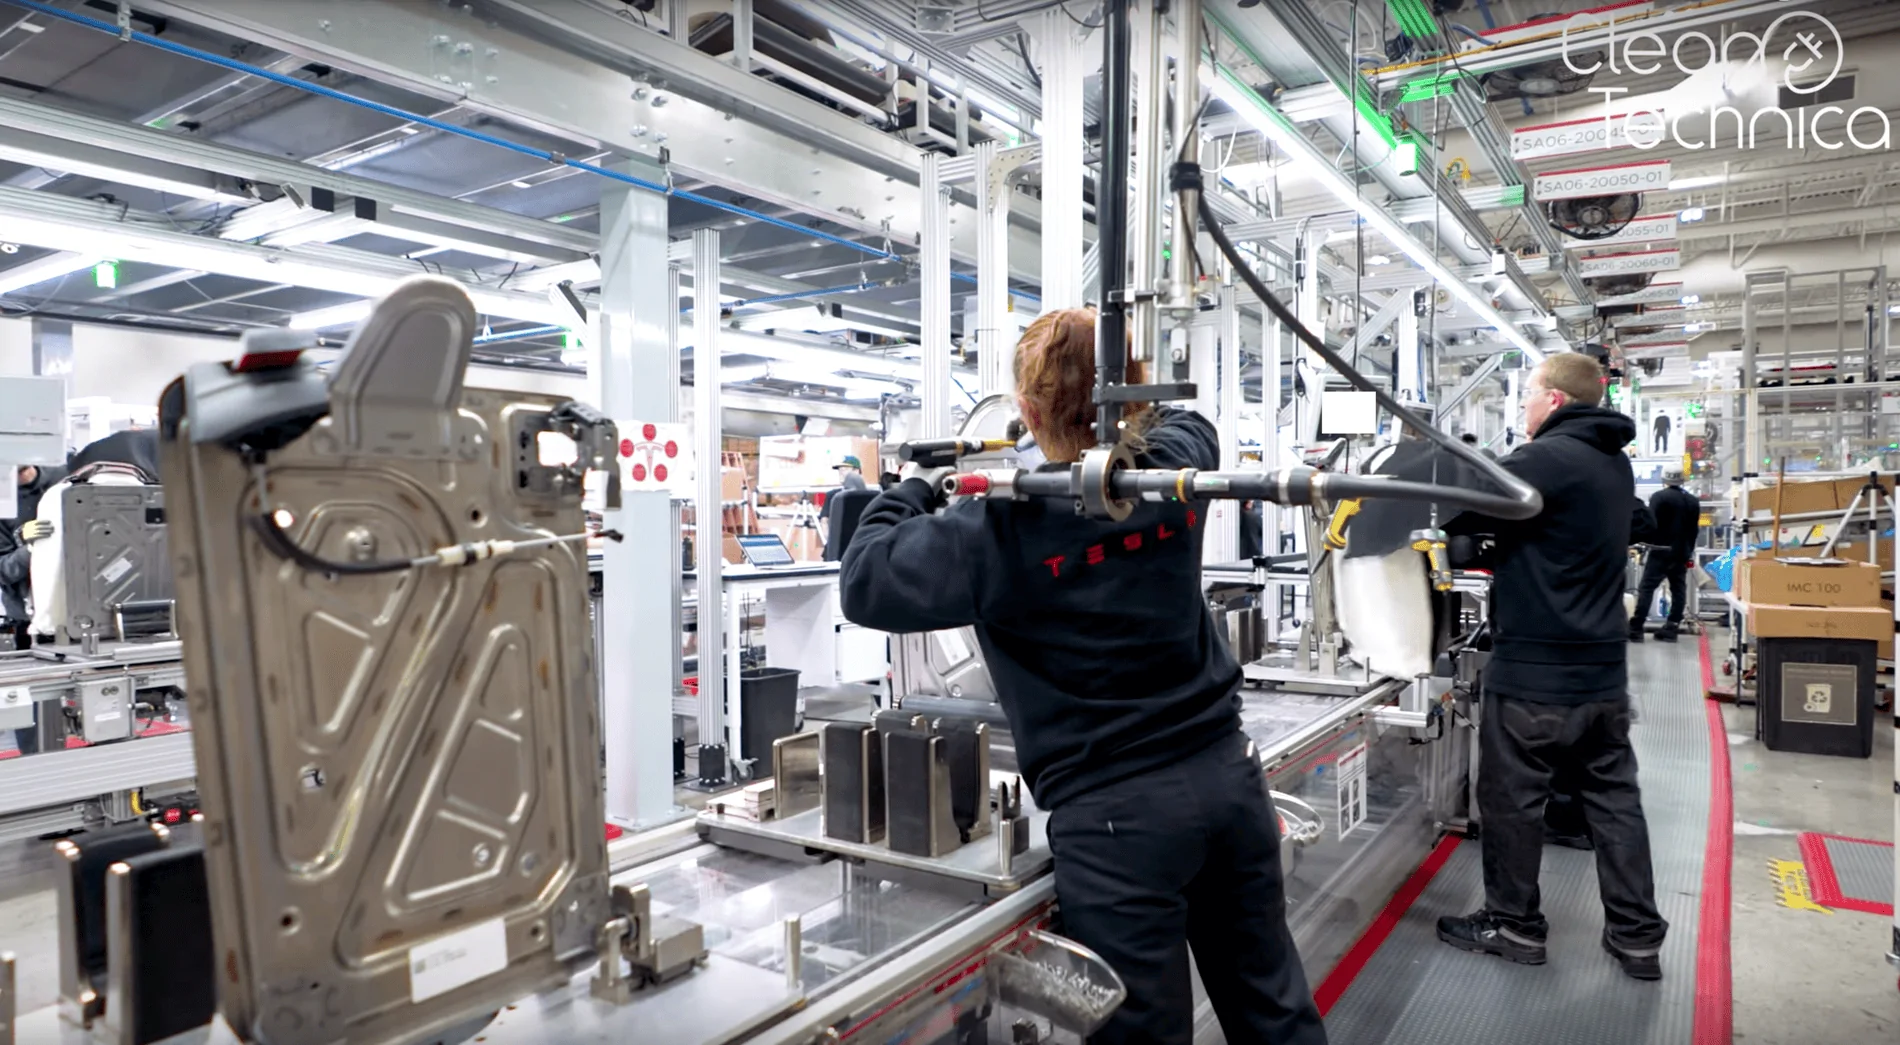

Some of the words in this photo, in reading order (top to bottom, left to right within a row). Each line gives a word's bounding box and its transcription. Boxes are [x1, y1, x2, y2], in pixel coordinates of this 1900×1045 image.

[1544, 171, 1662, 193] SA06-20050-01
[1617, 224, 1669, 237] 0055-01
[1585, 257, 1675, 271] SA06-20060-01
[1787, 582, 1812, 593] IMC
[1817, 583, 1841, 593] 100
